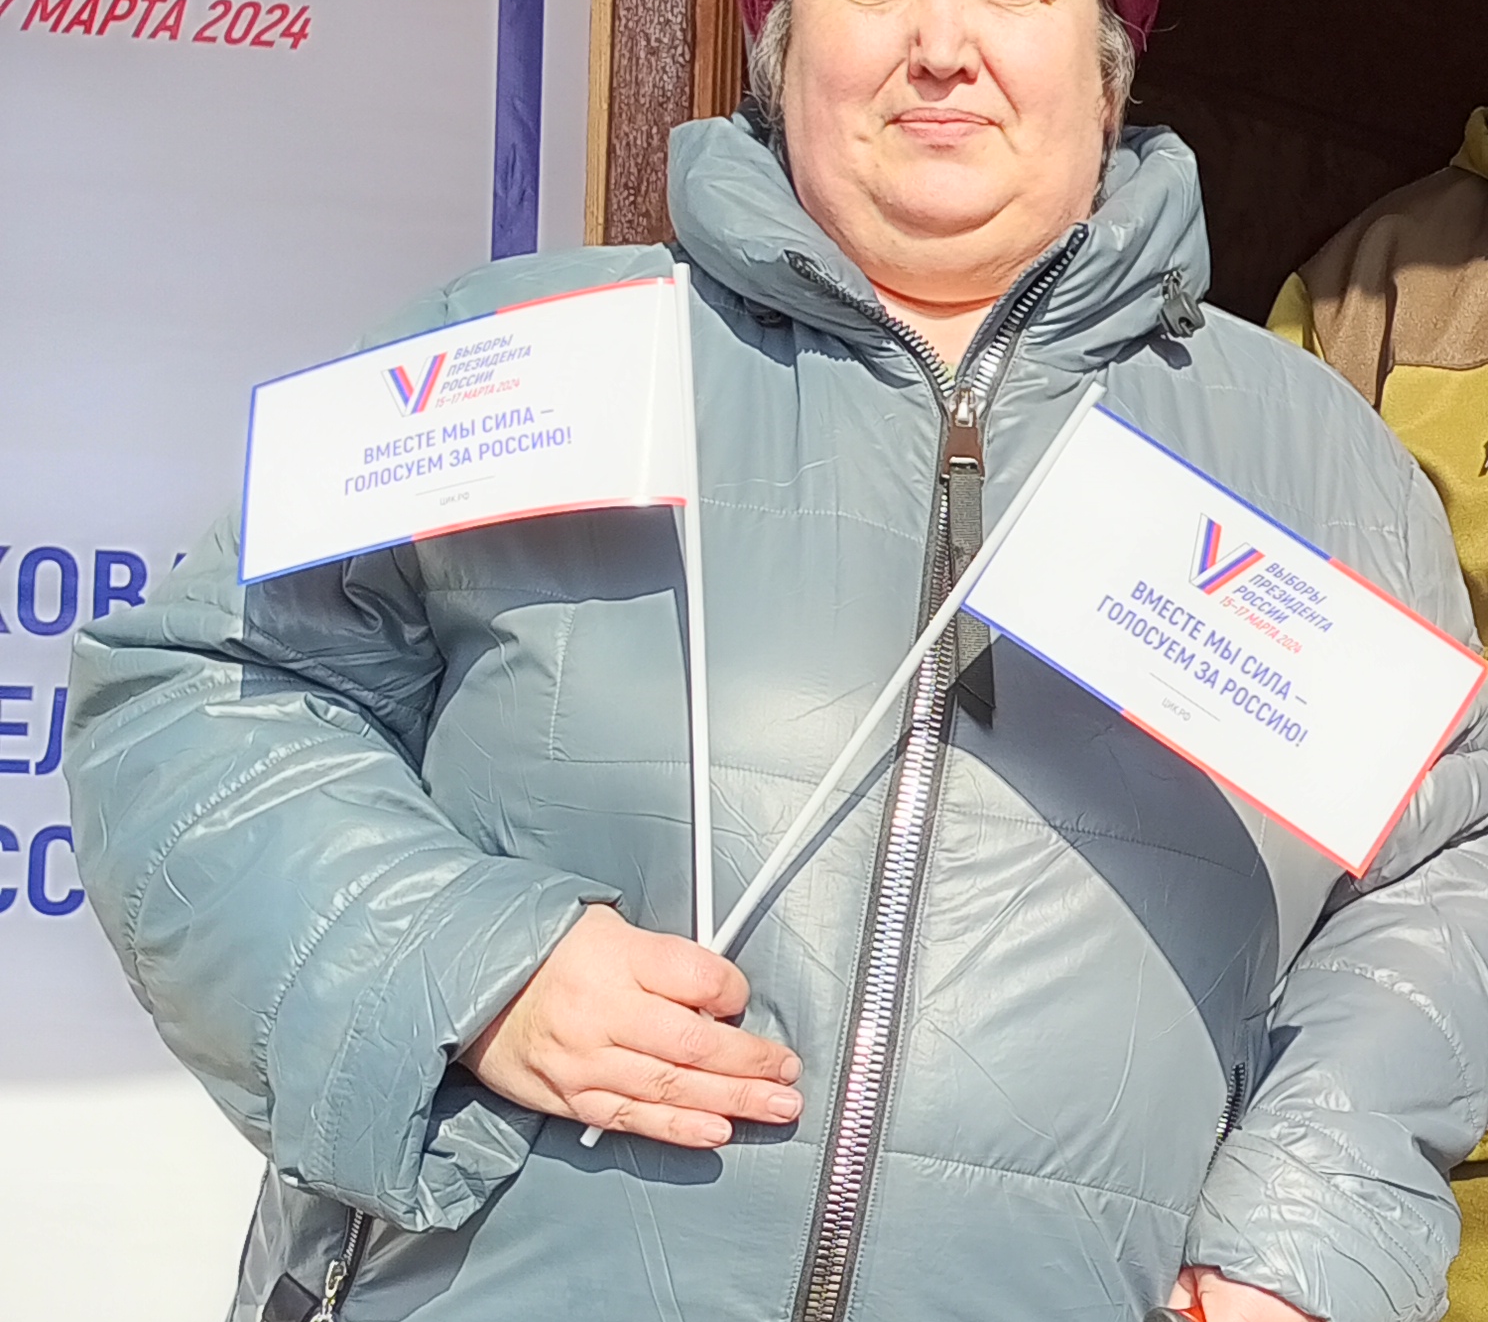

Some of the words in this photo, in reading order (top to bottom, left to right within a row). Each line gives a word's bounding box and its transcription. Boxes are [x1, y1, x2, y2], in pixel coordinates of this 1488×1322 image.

[193, 0, 311, 50] 2024
[446, 345, 532, 377] ПРЕЗИДЕНТА
[453, 334, 513, 360] ВЫБОРЫ
[440, 369, 495, 394] РОССИИ
[463, 384, 495, 401] МАРТА
[496, 378, 520, 392] 2024
[363, 429, 436, 464] ВМЕСТЕ
[442, 419, 475, 444] МЫ
[482, 406, 535, 433] СИЛА
[344, 453, 443, 496] ГОЛОСУЕМ
[449, 447, 472, 467] ЗА
[479, 426, 572, 460] РОССИЮ!
[1232, 585, 1290, 624] РОССИИ
[1248, 574, 1333, 633] ПРЕЗИДЕНТА
[1265, 562, 1328, 605] ВЫБОРЫ
[1130, 580, 1205, 640] ВМЕСТЕ
[1203, 630, 1242, 665] МЫ
[1240, 655, 1292, 700] СИЛА
[1244, 613, 1280, 639] МАРТА
[1275, 634, 1303, 654] 2024
[1097, 595, 1196, 671] ГОЛОСУЕМ
[1194, 661, 1220, 689] ЗА
[1220, 678, 1308, 747] РОССИЮ!
